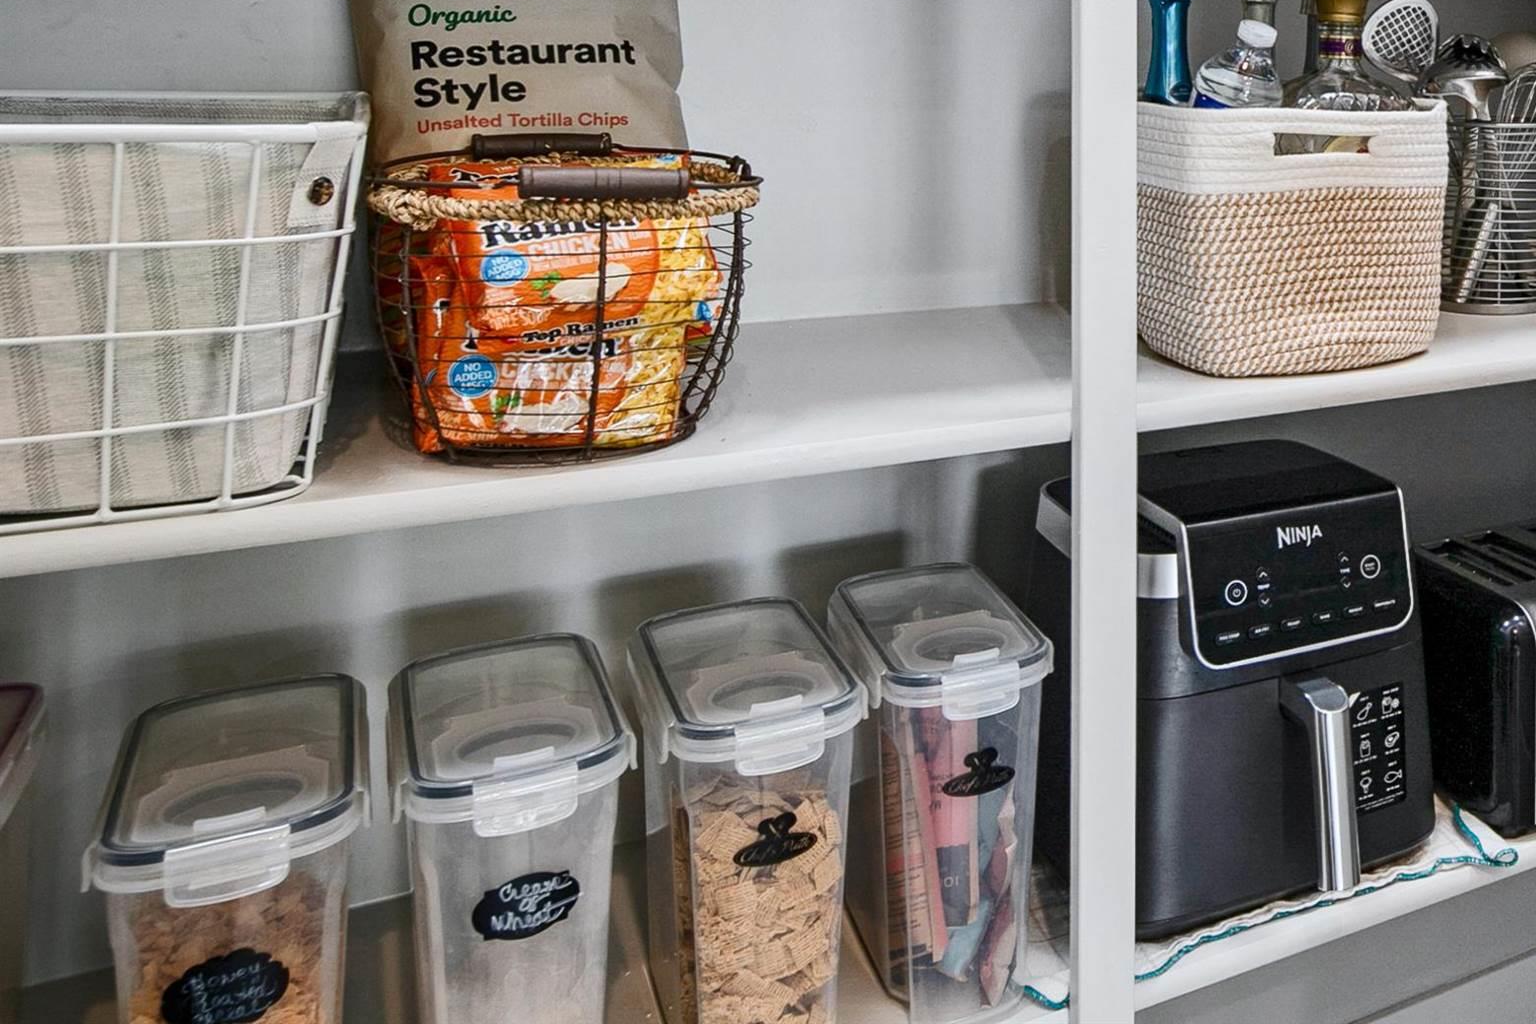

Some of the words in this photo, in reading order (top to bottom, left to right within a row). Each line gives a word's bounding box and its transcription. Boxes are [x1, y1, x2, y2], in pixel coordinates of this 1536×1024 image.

[408, 3, 517, 31] Organic
[410, 39, 636, 70] Restaurant
[413, 74, 526, 110] Style
[417, 114, 501, 134] Unsalted
[509, 112, 573, 128] Tortilla
[579, 112, 629, 127] Chips
[523, 327, 560, 343] Top
[565, 317, 640, 336] Ramen
[454, 371, 493, 383] ADDED
[463, 363, 482, 373] NO
[1276, 524, 1323, 549] NINJA
